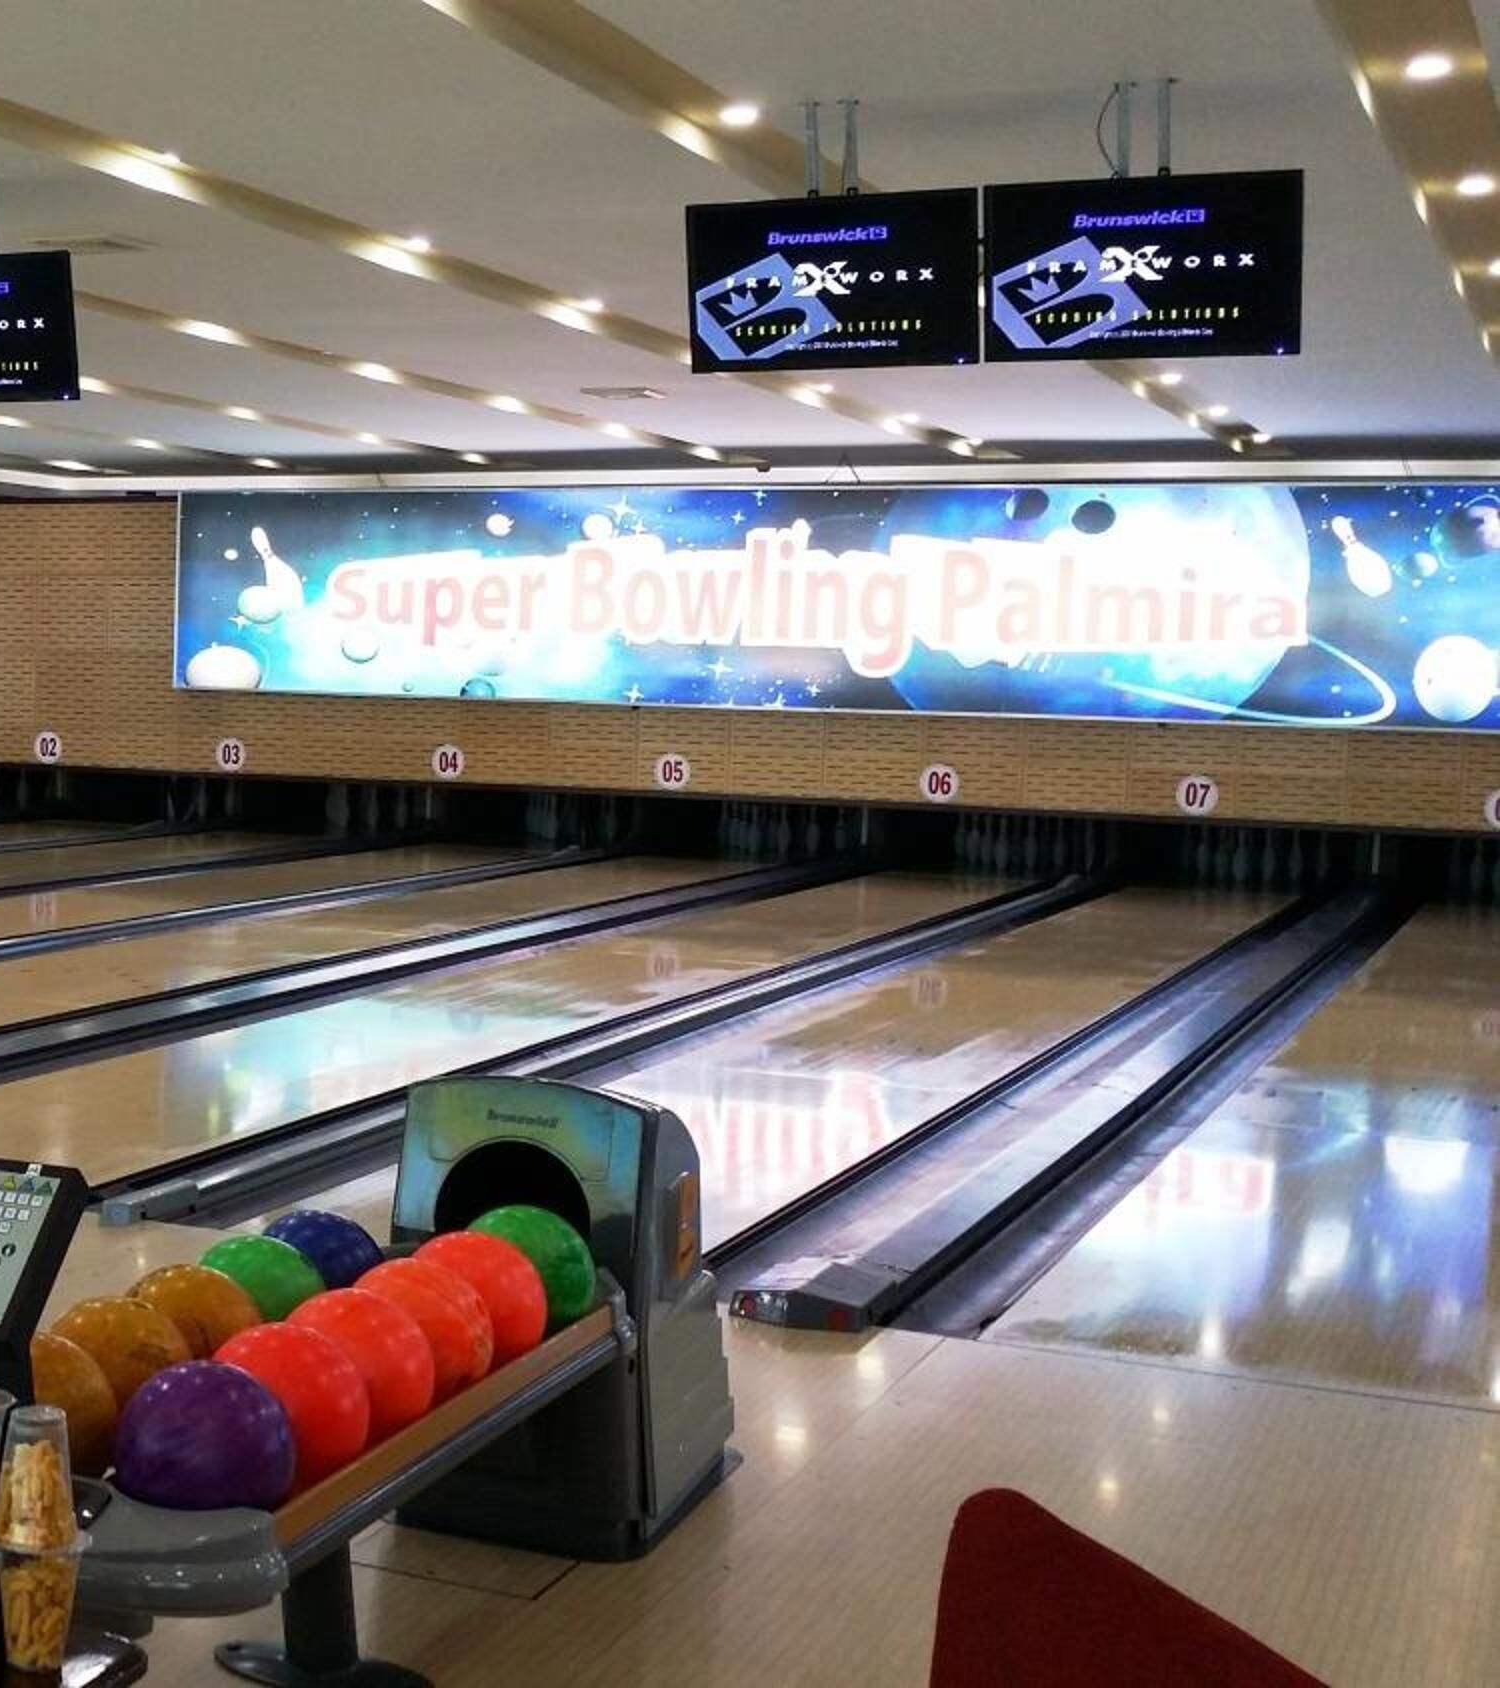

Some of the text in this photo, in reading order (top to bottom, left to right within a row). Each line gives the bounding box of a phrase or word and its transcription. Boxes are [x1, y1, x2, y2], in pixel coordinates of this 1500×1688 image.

[1073, 210, 1187, 229] Brunswick
[767, 227, 870, 246] Brunswick
[332, 539, 1298, 671] Super Bowling Palmira
[39, 737, 58, 757] 02
[222, 743, 240, 765] 03
[438, 751, 459, 773] 04
[662, 760, 684, 783] 05
[928, 770, 951, 795] 06
[1185, 782, 1211, 808] 07
